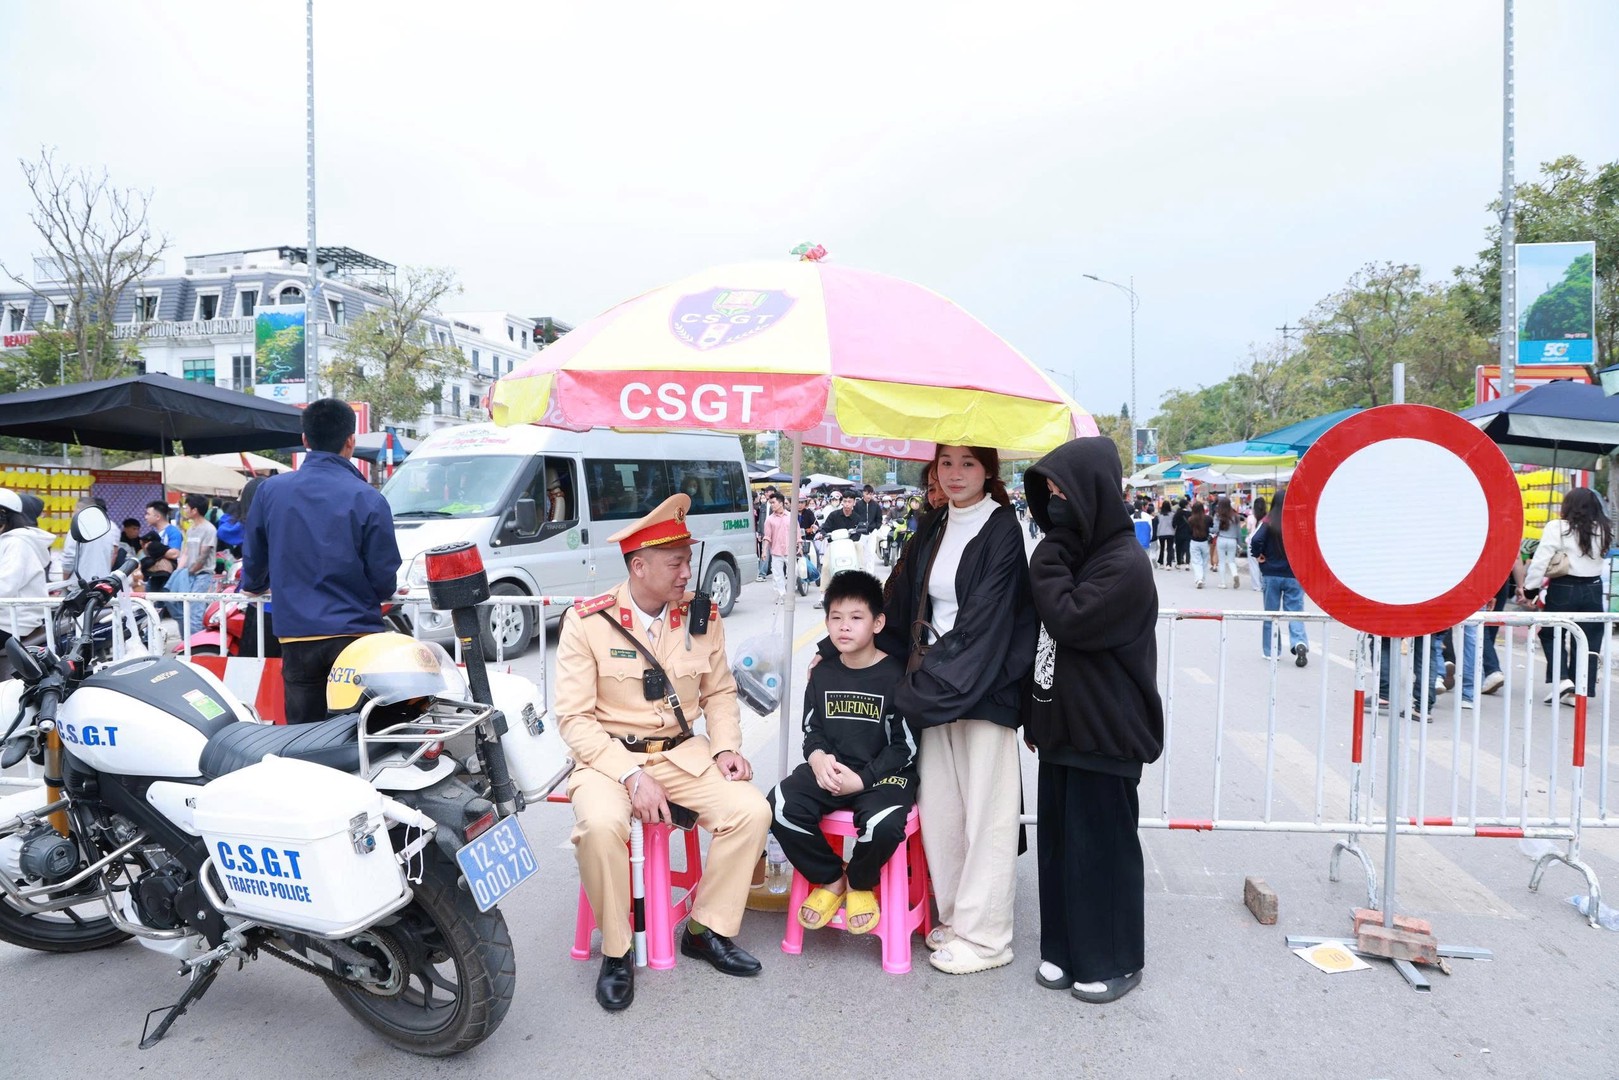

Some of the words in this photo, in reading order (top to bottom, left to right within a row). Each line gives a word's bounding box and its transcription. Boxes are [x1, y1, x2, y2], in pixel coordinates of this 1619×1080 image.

[679, 312, 775, 325] CSGT
[1543, 343, 1570, 356] 5G
[619, 381, 764, 423] CSGT
[827, 700, 880, 720] CALIFONIA
[56, 719, 118, 747] C.S.G.T
[216, 840, 302, 880] C.S.G.T
[469, 824, 517, 872] 12-G3
[225, 874, 269, 897] TRAFFIC
[269, 881, 313, 904] POLICE
[475, 846, 534, 905] 000.70
